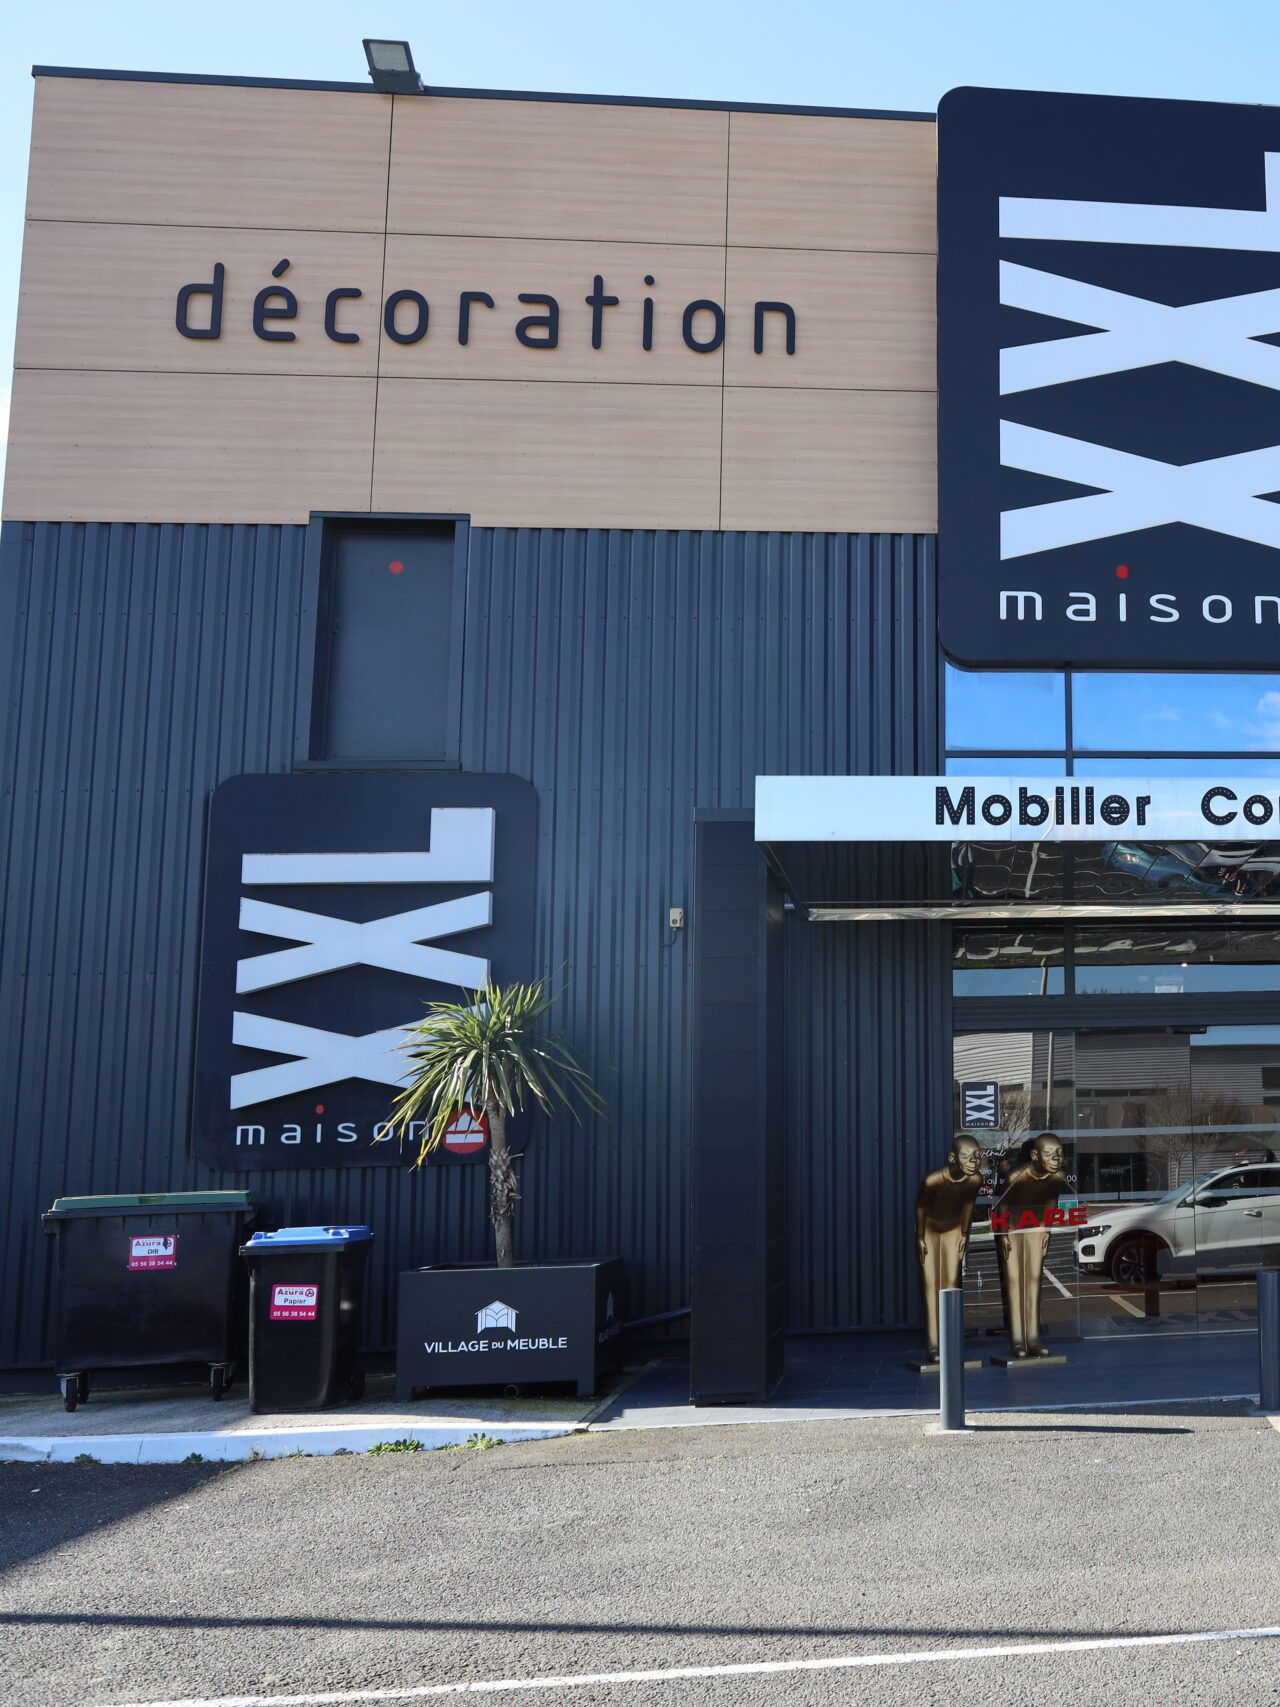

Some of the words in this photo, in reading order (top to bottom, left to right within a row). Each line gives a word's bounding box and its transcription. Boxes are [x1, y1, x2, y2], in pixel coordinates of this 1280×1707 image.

[175, 258, 797, 356] décoration
[935, 786, 1151, 827] Mobilier
[230, 807, 496, 1110] XXL
[966, 1085, 995, 1122] XXL
[235, 1104, 431, 1146] maison
[991, 1207, 1088, 1232] KARE
[277, 1288, 304, 1296] Azura
[283, 1297, 307, 1305] Papier
[424, 1340, 489, 1353] VILLAGE
[491, 1341, 504, 1349] DU
[507, 1337, 568, 1350] MEUBLE
